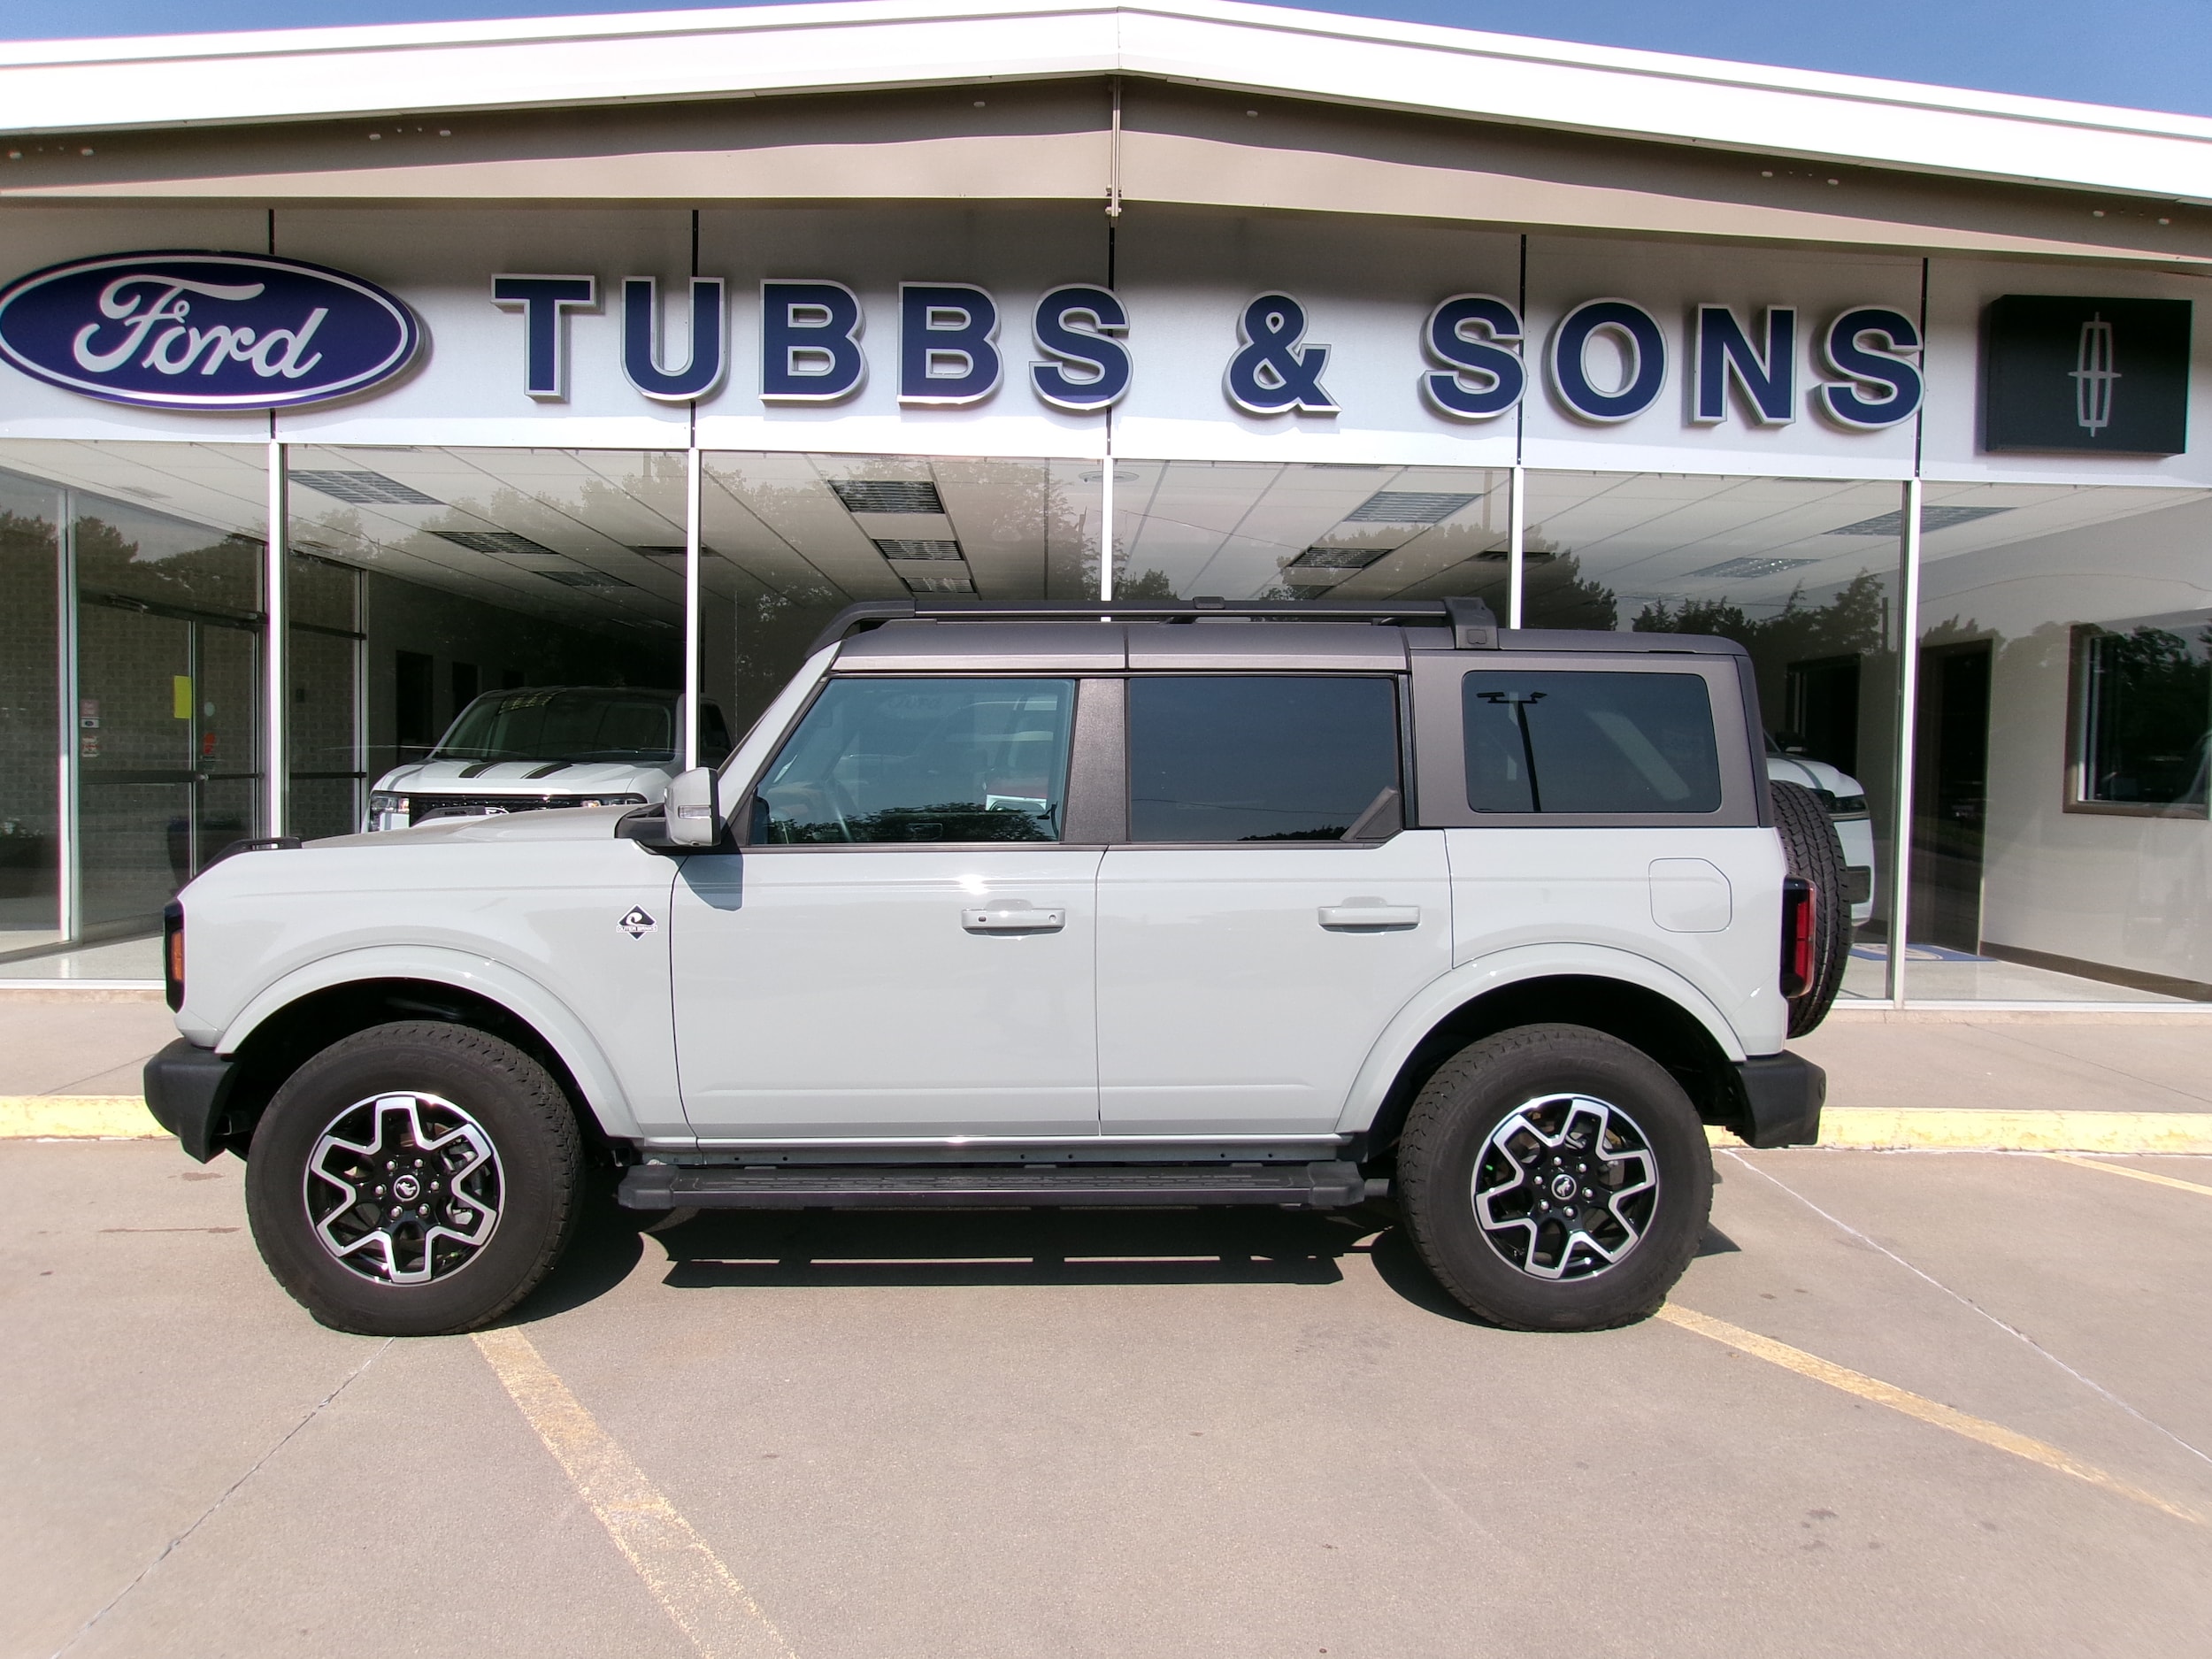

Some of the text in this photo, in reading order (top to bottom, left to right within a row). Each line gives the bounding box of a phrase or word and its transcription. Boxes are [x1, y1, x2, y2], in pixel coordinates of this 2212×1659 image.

[73, 273, 329, 379] Ford
[490, 273, 1926, 431] TUBBS & SONS
